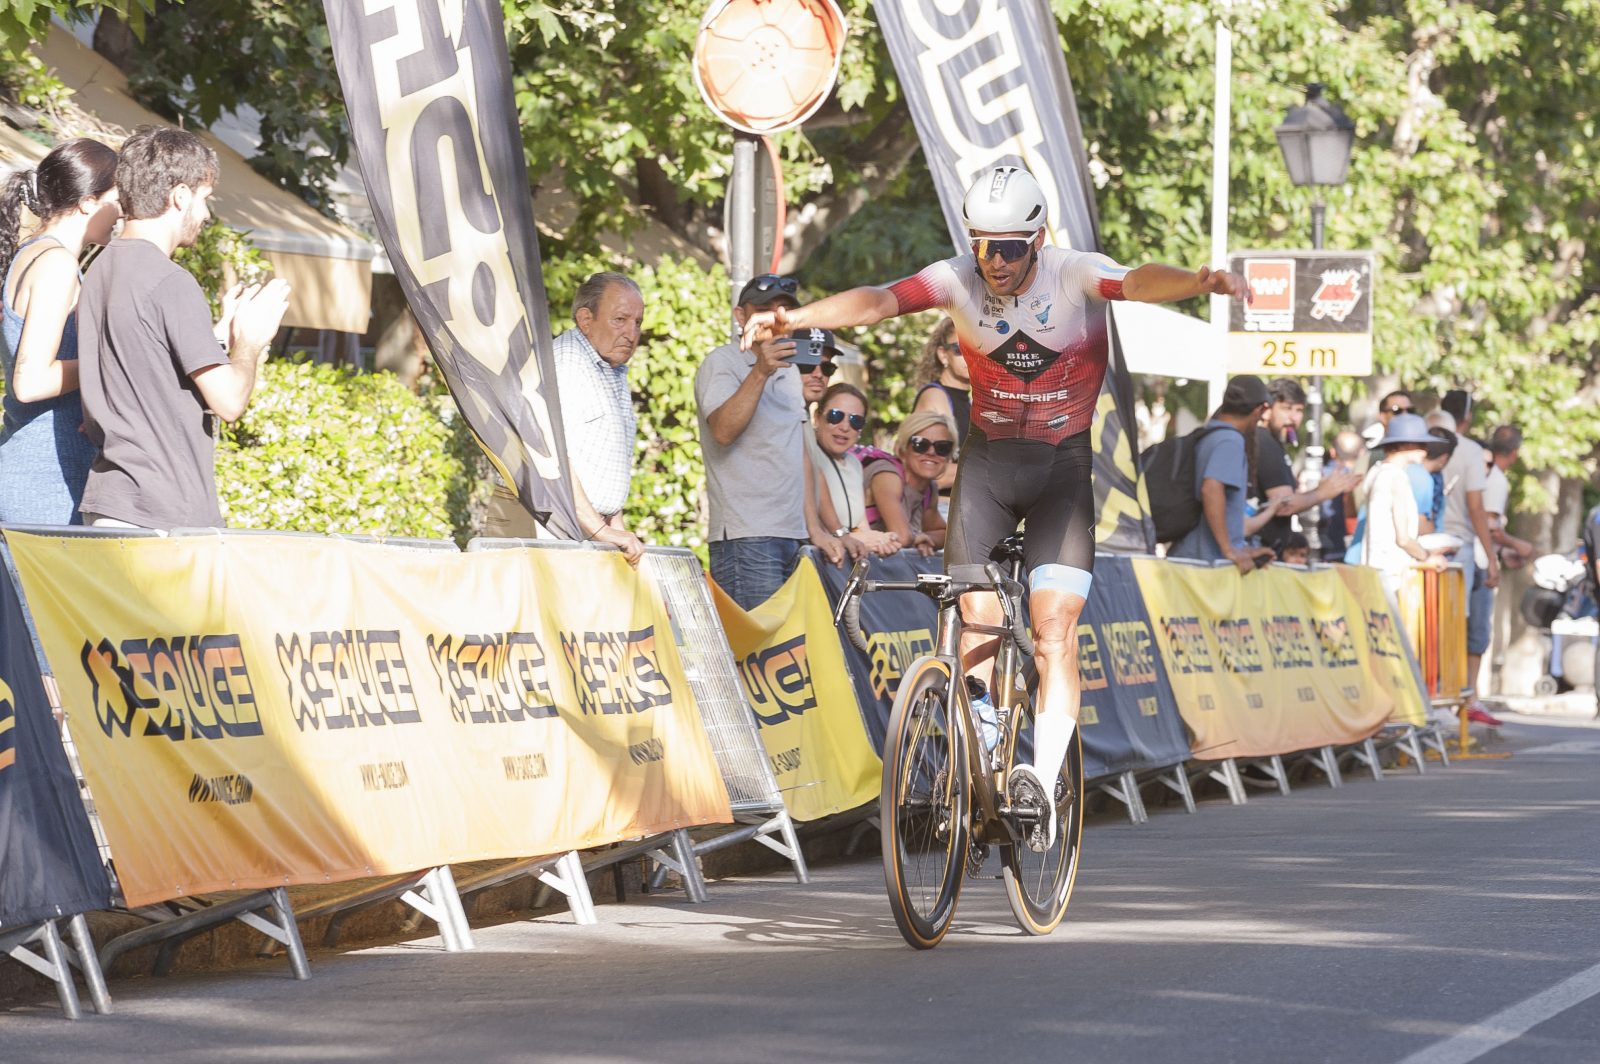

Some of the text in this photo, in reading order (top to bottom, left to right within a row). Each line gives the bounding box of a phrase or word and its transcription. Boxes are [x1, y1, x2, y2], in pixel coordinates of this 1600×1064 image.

[1006, 353, 1040, 361] BIKE
[1262, 340, 1337, 368] 25 m
